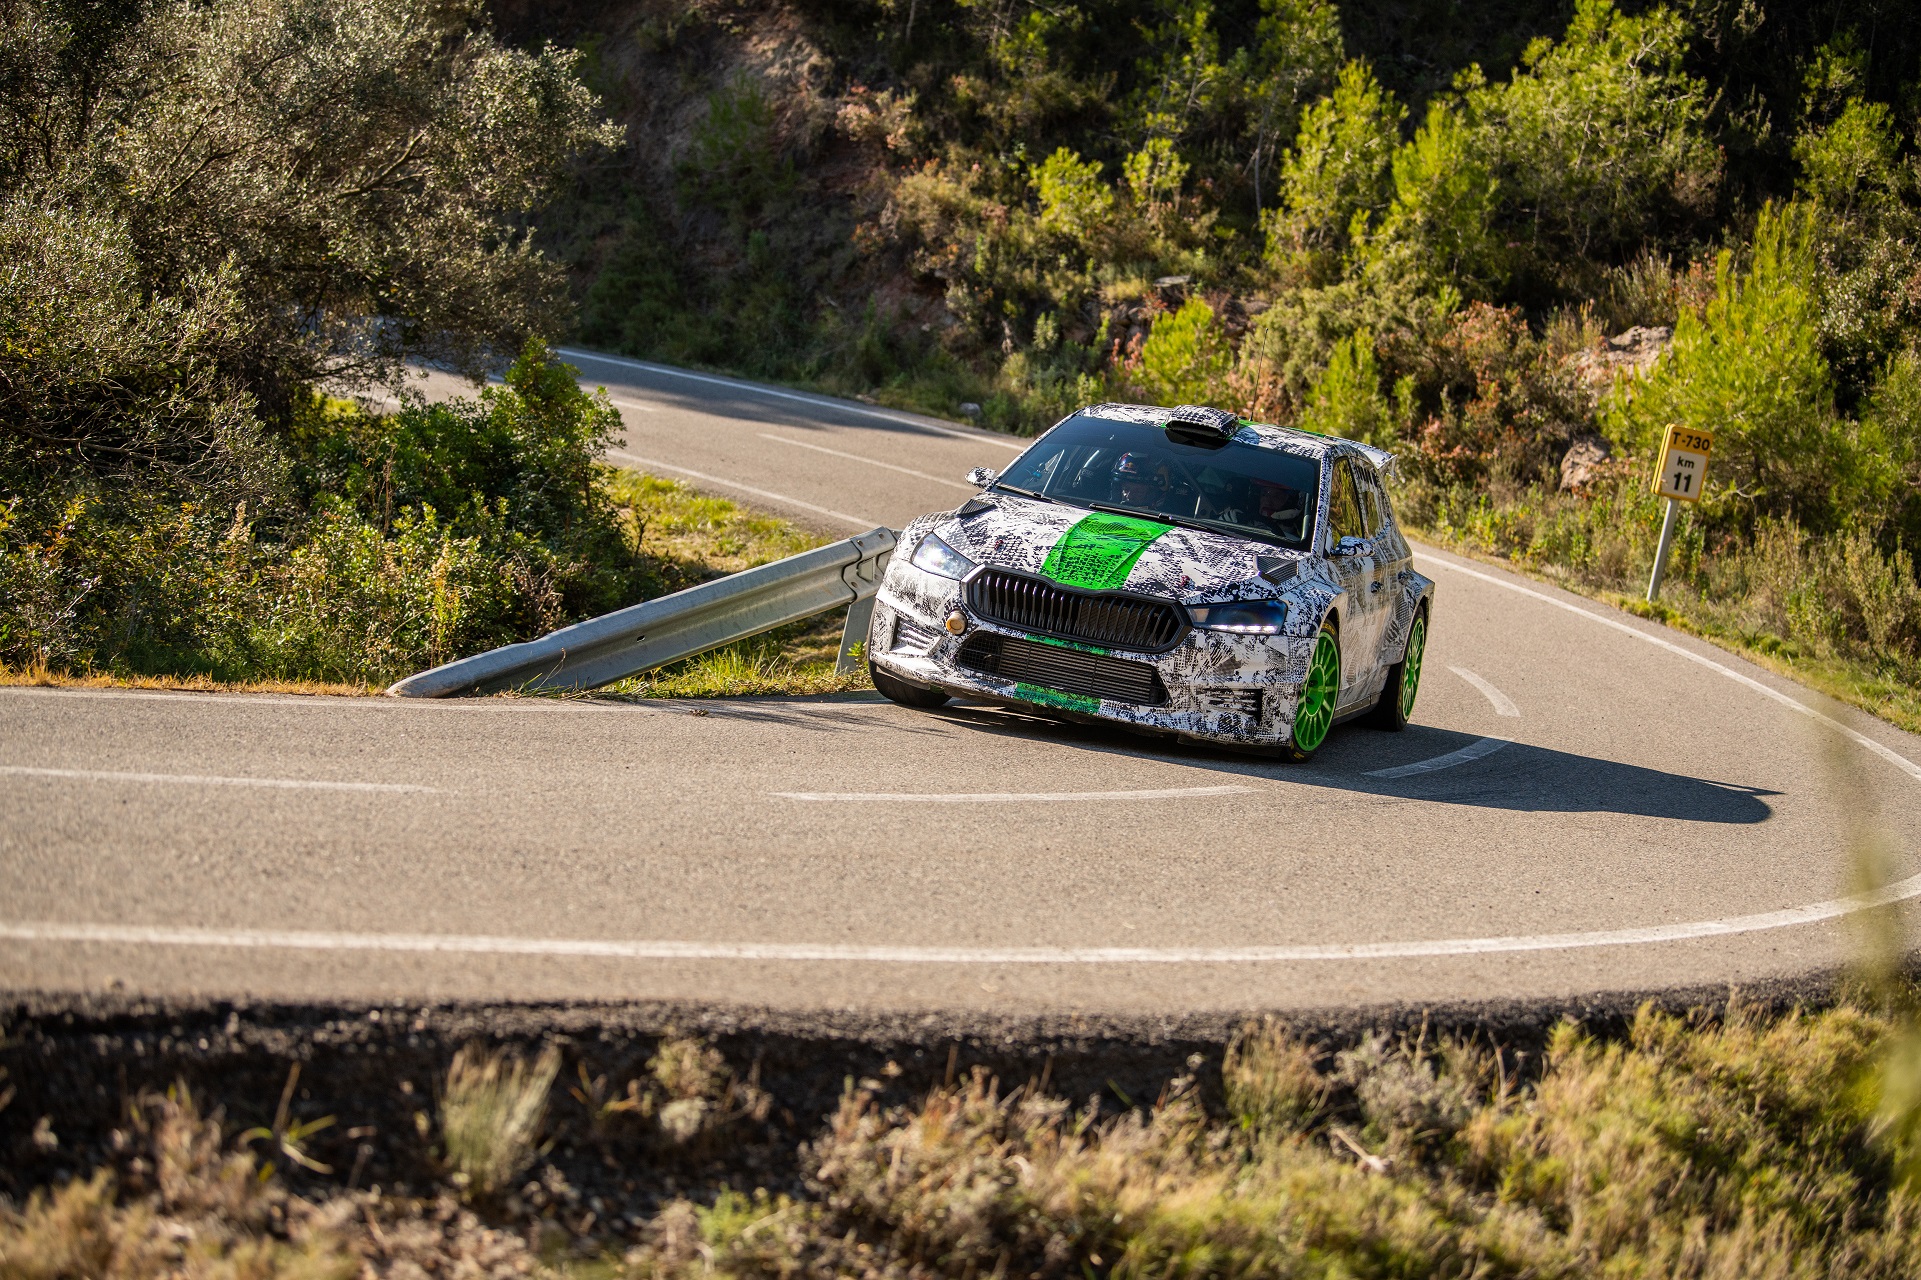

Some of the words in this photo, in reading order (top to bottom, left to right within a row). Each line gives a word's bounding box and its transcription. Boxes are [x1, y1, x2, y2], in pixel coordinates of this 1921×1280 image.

[1673, 432, 1710, 451] T-730
[1677, 456, 1695, 469] km
[1673, 472, 1692, 493] 11
